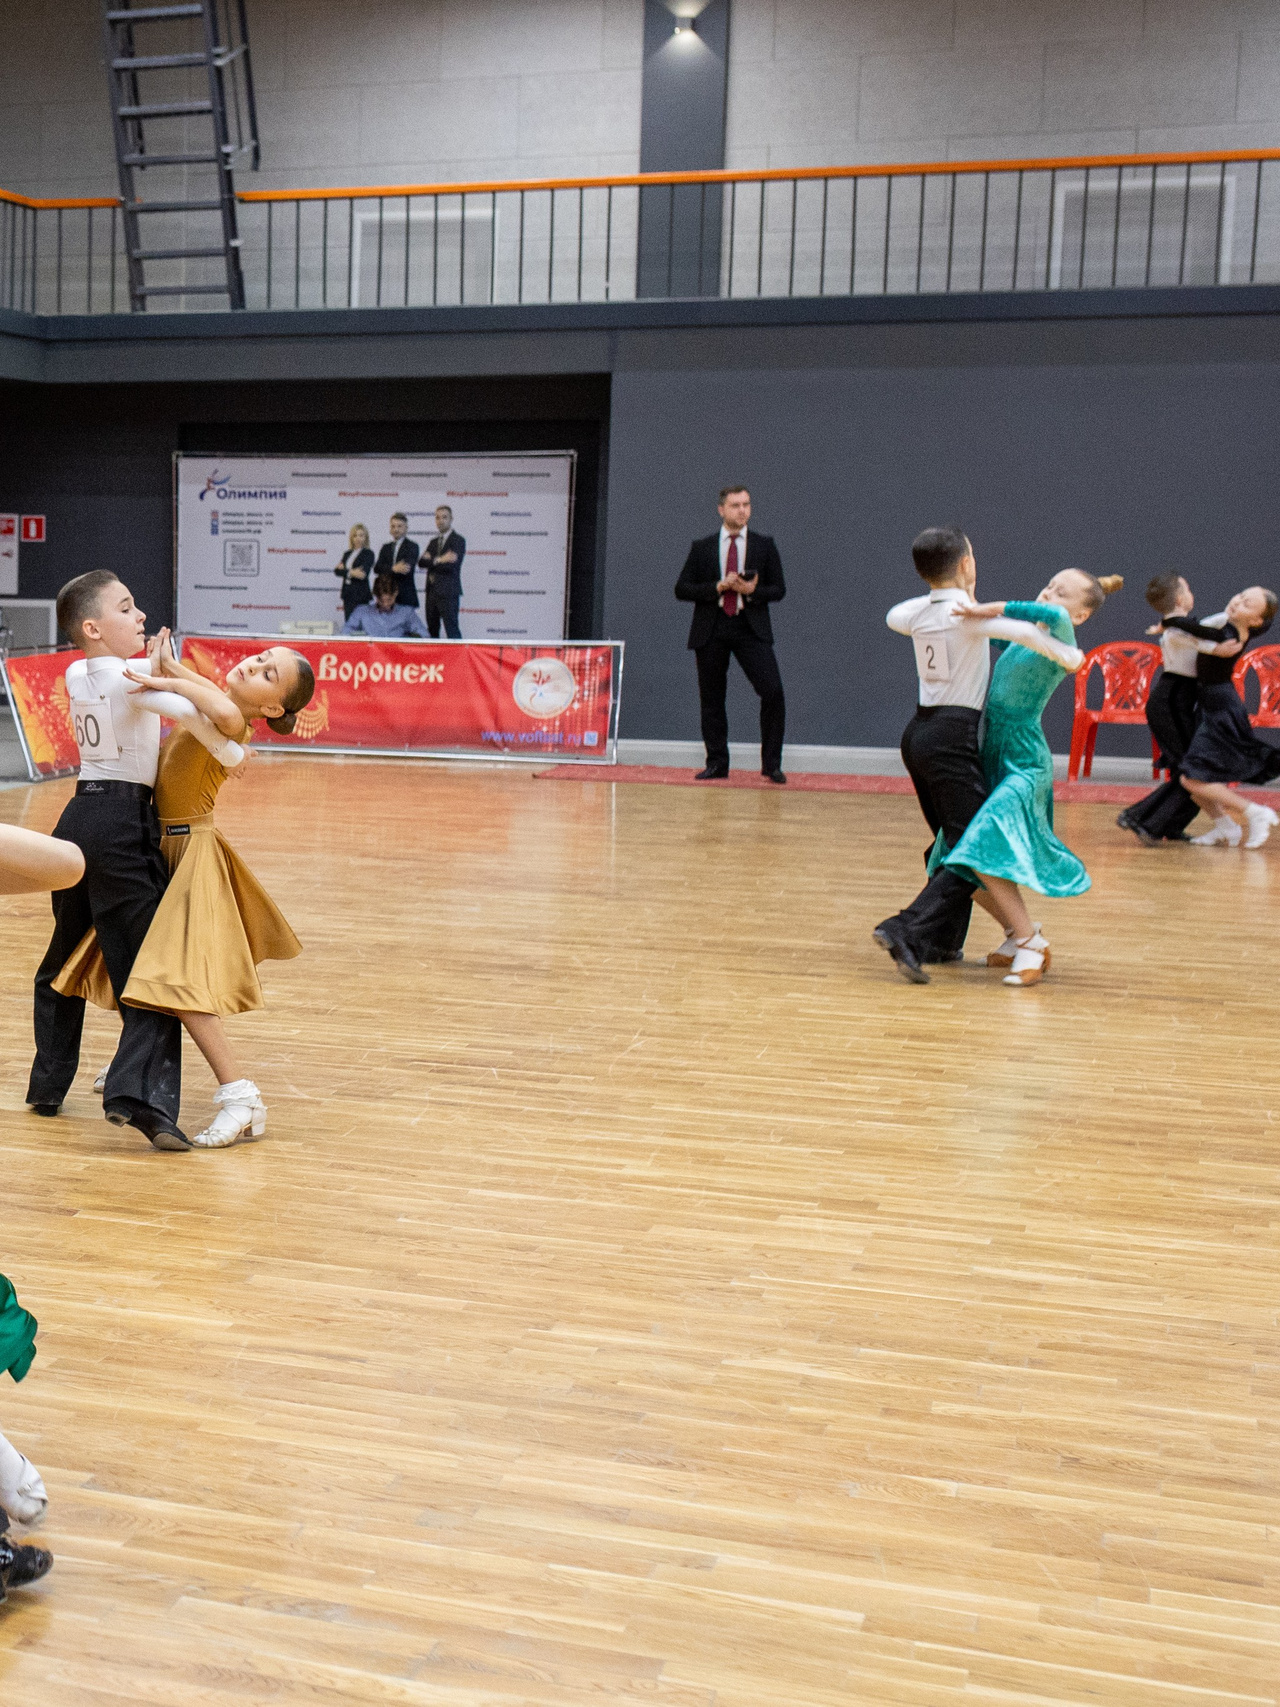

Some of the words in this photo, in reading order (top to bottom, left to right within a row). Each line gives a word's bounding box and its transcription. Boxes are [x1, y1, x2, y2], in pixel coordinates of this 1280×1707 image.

[216, 488, 287, 500] Олимпия
[317, 653, 445, 690] Воронеж
[925, 645, 936, 669] 2
[75, 713, 100, 748] 60
